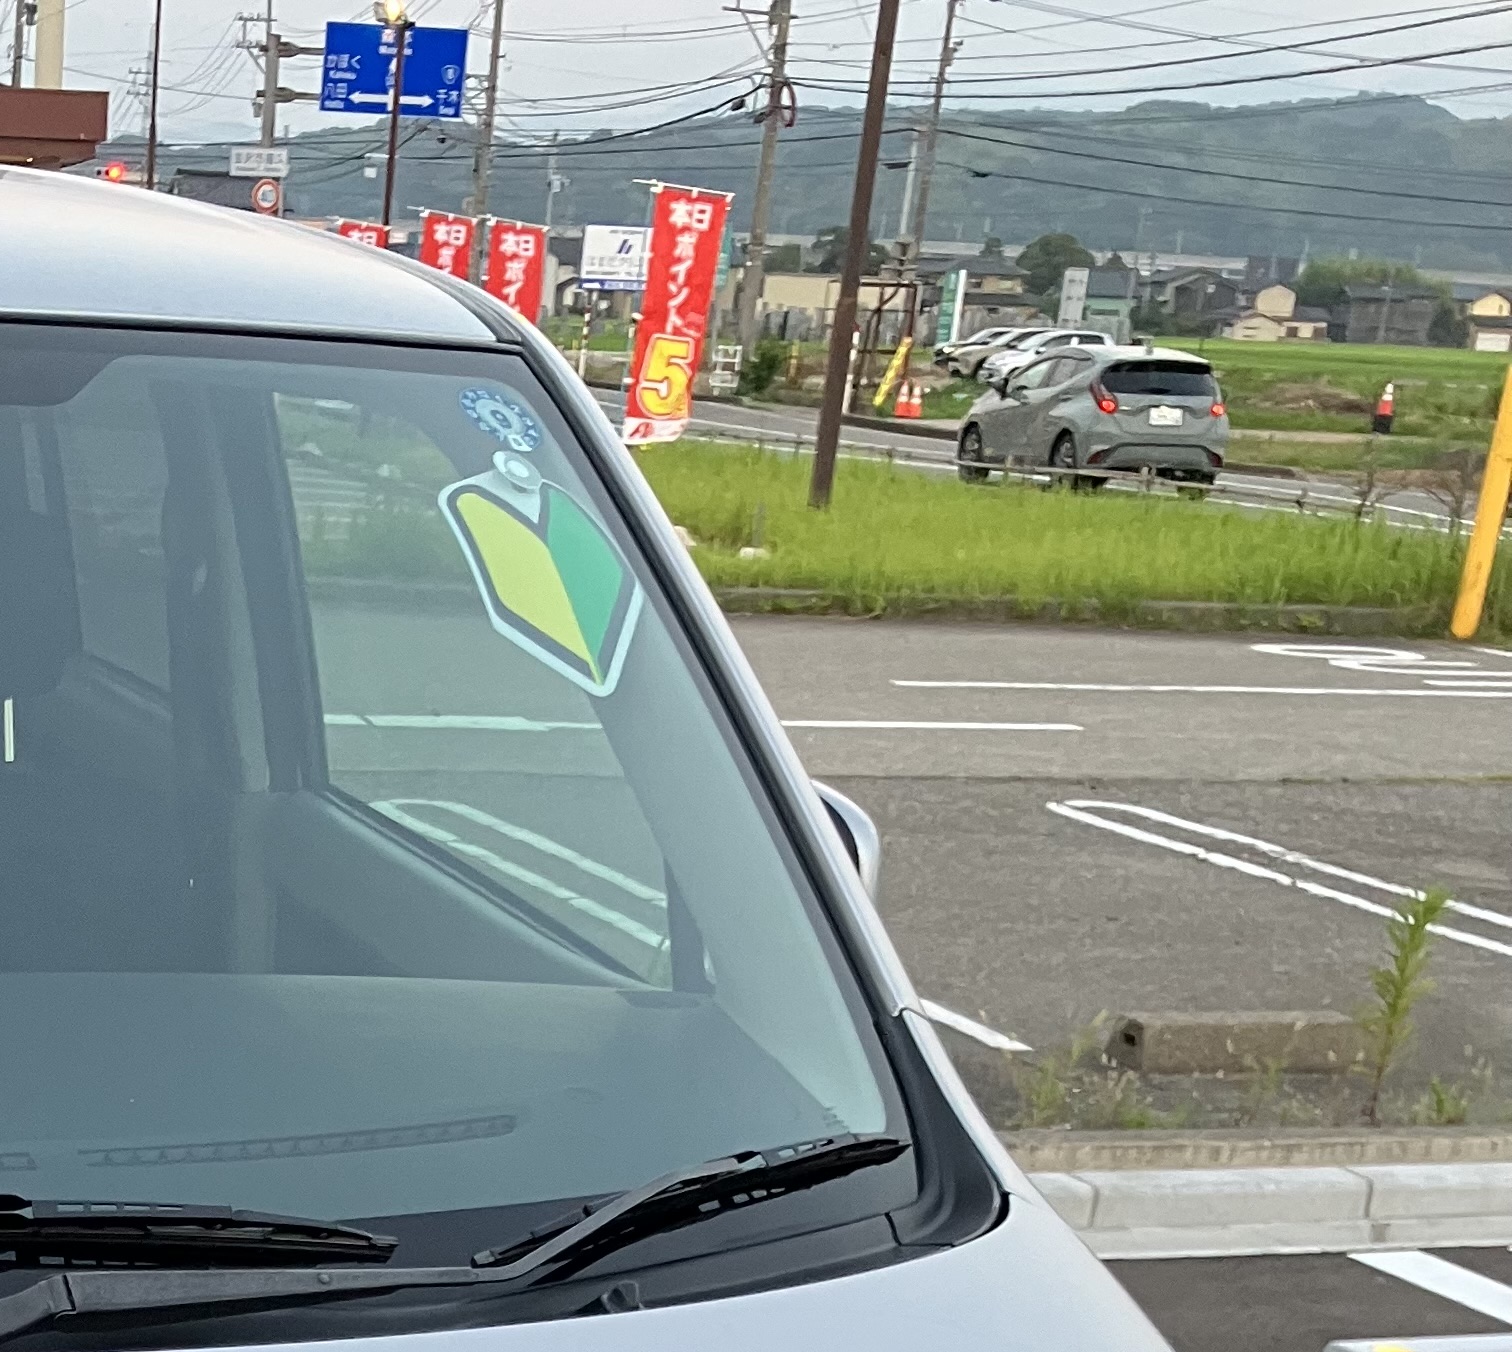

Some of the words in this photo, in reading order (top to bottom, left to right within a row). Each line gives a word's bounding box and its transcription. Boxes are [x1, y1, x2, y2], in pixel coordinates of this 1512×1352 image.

[669, 199, 713, 231] 本日
[434, 222, 467, 247] 本日
[500, 232, 535, 257] 本日
[637, 334, 694, 418] 5
